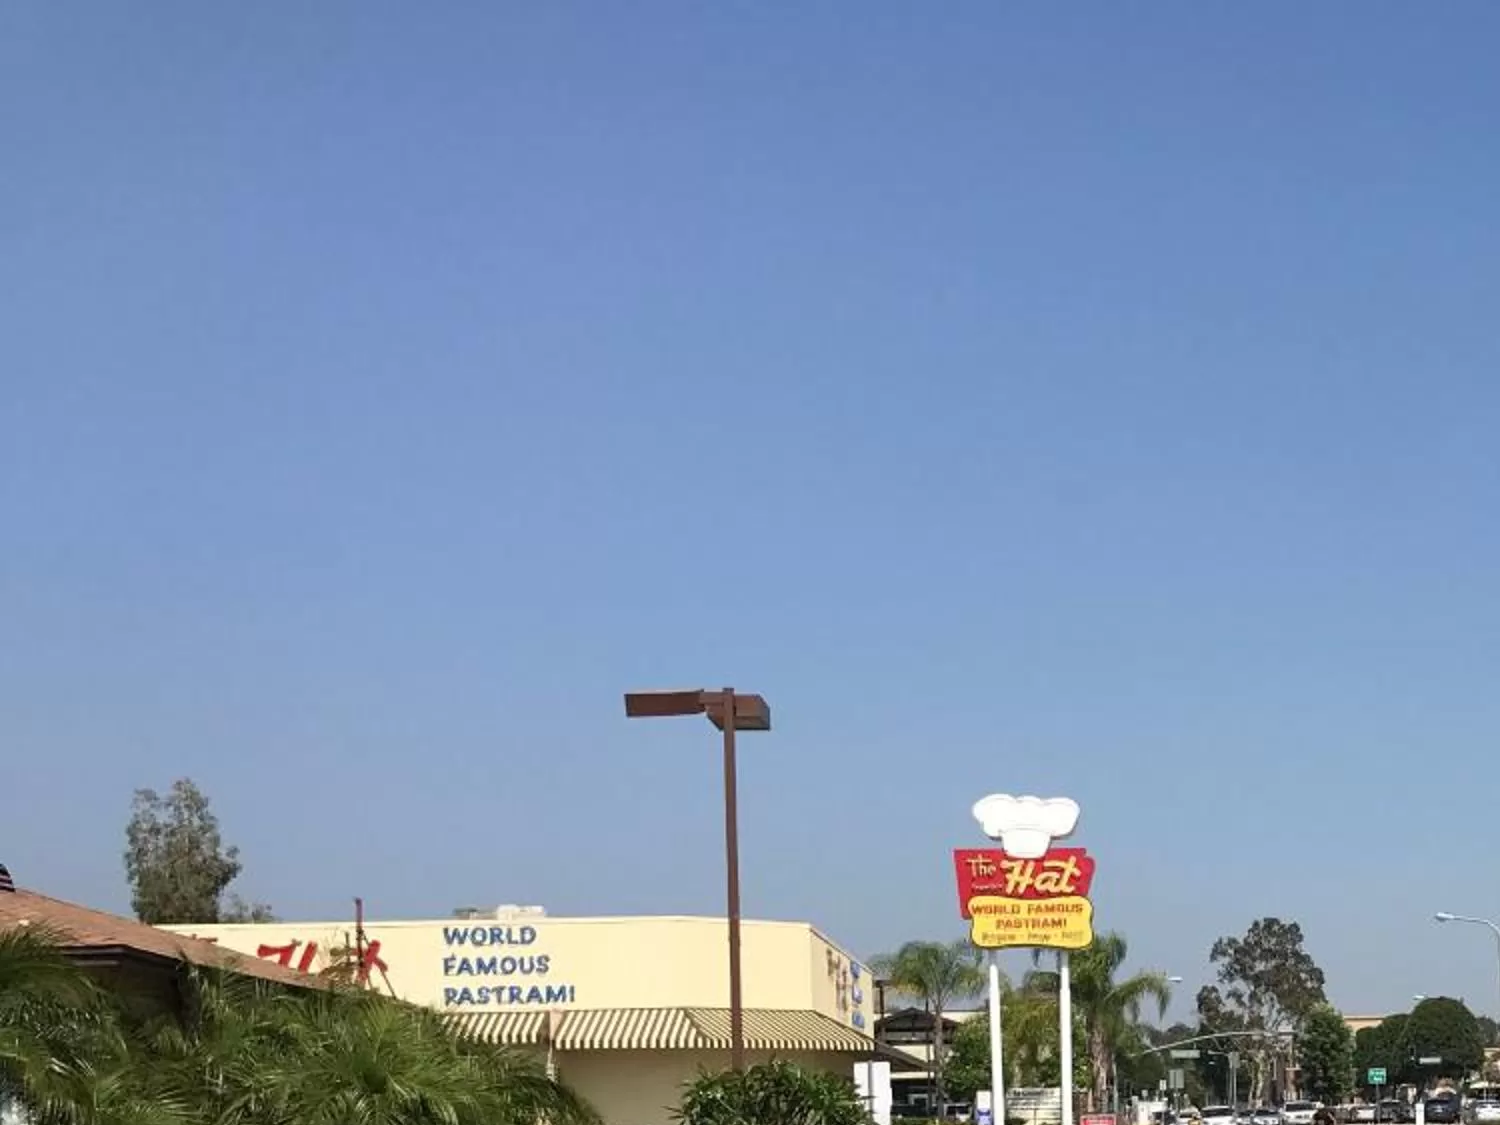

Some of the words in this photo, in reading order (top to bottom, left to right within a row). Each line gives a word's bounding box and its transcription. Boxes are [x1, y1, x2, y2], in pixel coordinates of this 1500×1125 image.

[967, 854, 996, 877] The
[1001, 856, 1081, 893] Hat
[971, 904, 1021, 915] WORLD
[1027, 903, 1084, 915] FAMOUS
[995, 918, 1067, 929] PASTRAMI
[443, 926, 537, 946] WORLD
[442, 955, 551, 976] FAMOUS
[443, 985, 575, 1006] PASTRAMI
